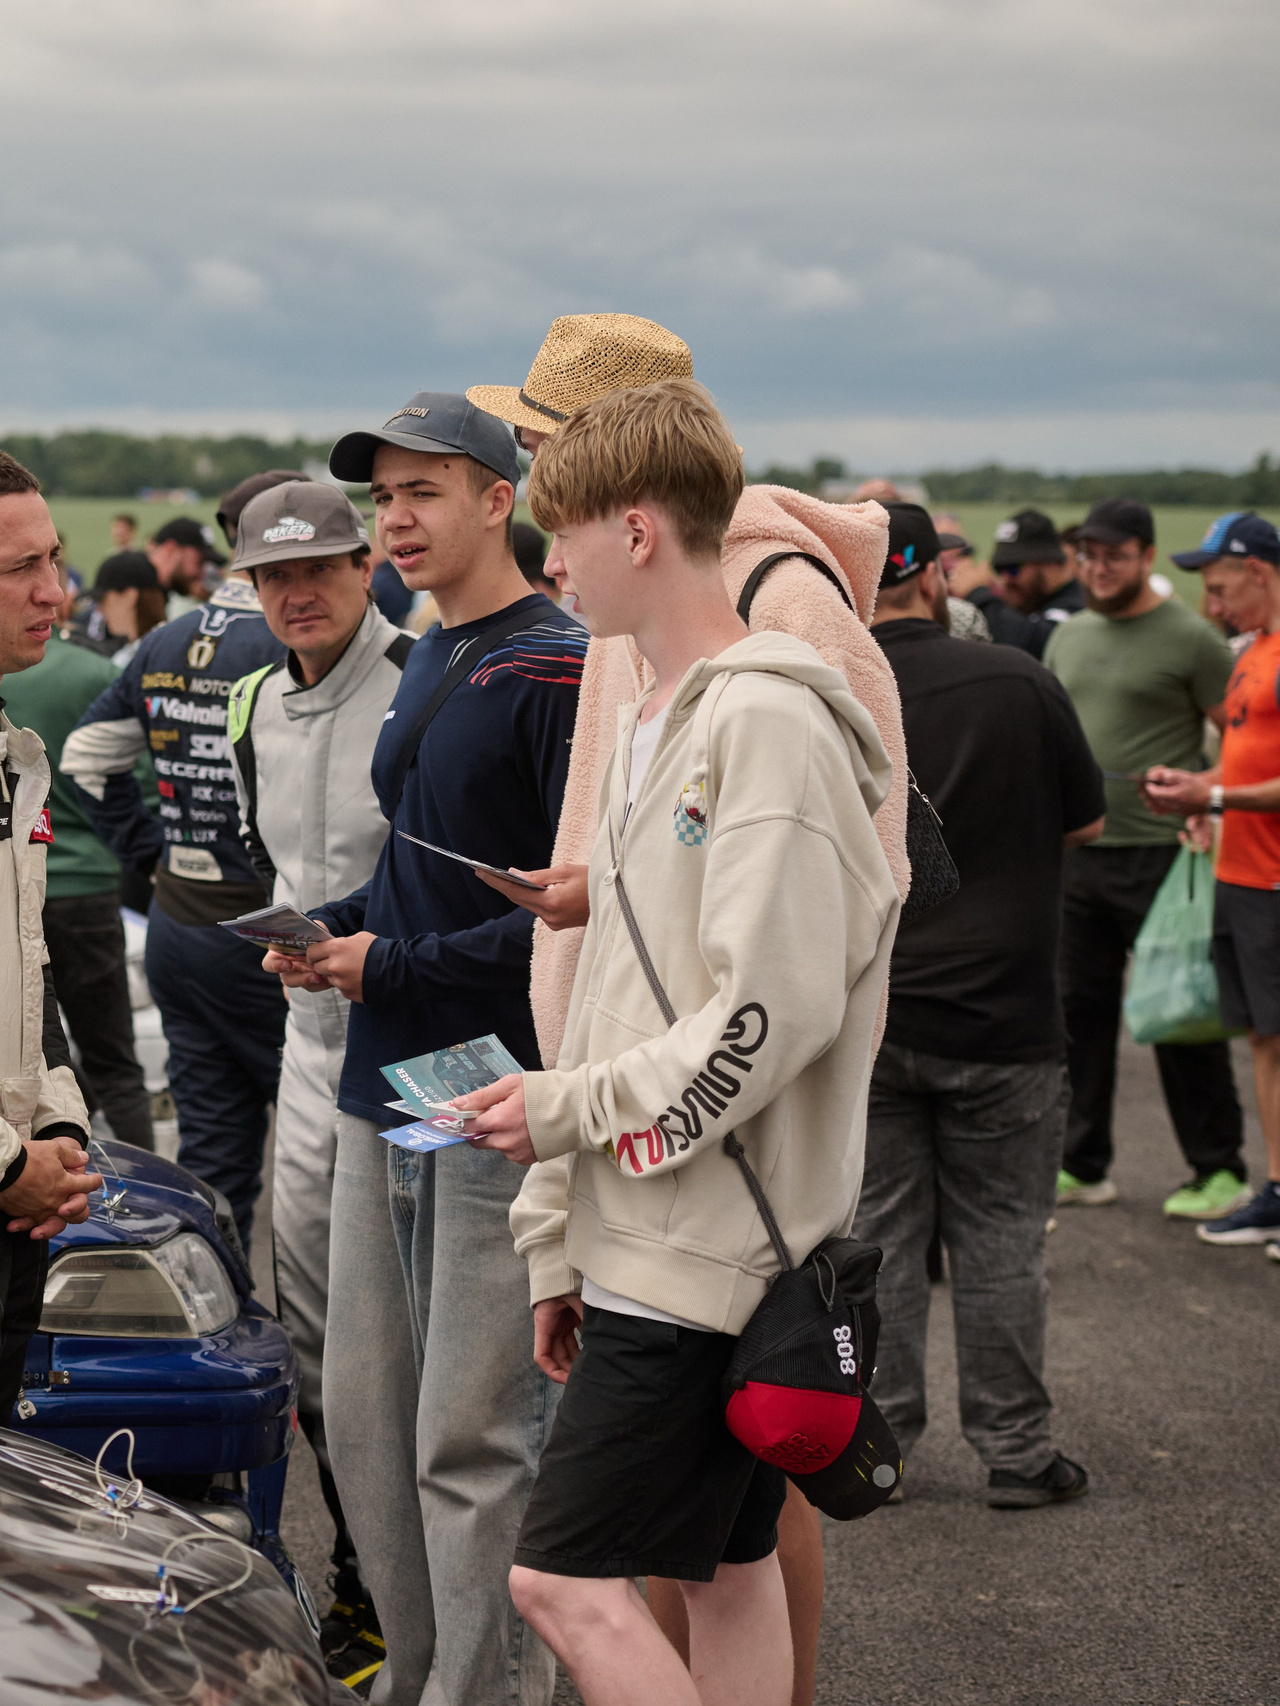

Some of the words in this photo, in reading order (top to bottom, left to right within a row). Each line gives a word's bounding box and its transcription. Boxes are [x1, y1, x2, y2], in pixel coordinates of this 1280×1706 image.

[189, 677, 234, 696] MOTO
[162, 697, 229, 727] Valvolin
[395, 1067, 425, 1099] CHASER
[613, 1002, 769, 1175] QUIKSILV
[833, 1325, 856, 1375] 808
